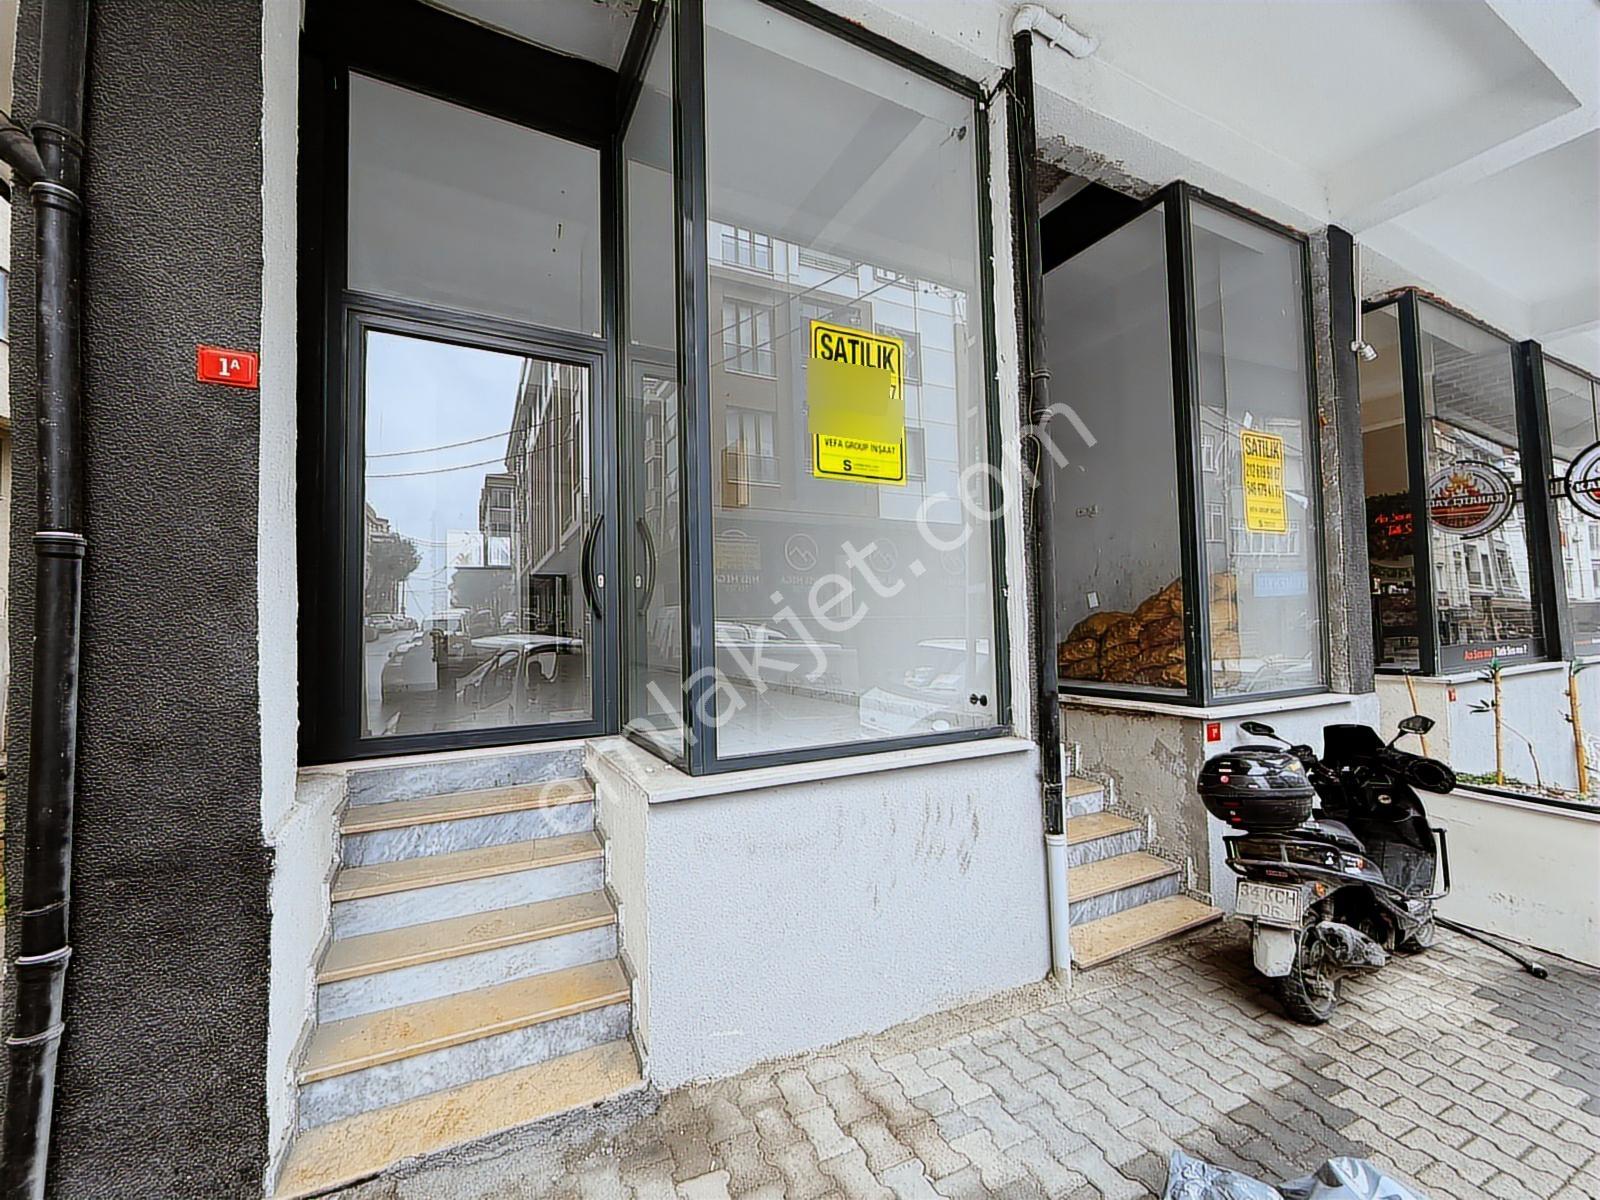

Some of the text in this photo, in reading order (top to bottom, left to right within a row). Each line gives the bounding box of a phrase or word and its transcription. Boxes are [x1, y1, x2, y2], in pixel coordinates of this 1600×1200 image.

[820, 333, 895, 373] SATILIK
[219, 358, 241, 376] 1A
[824, 438, 843, 448] VEFA
[844, 440, 869, 451] GROUP
[1245, 438, 1280, 459] SATILIK
